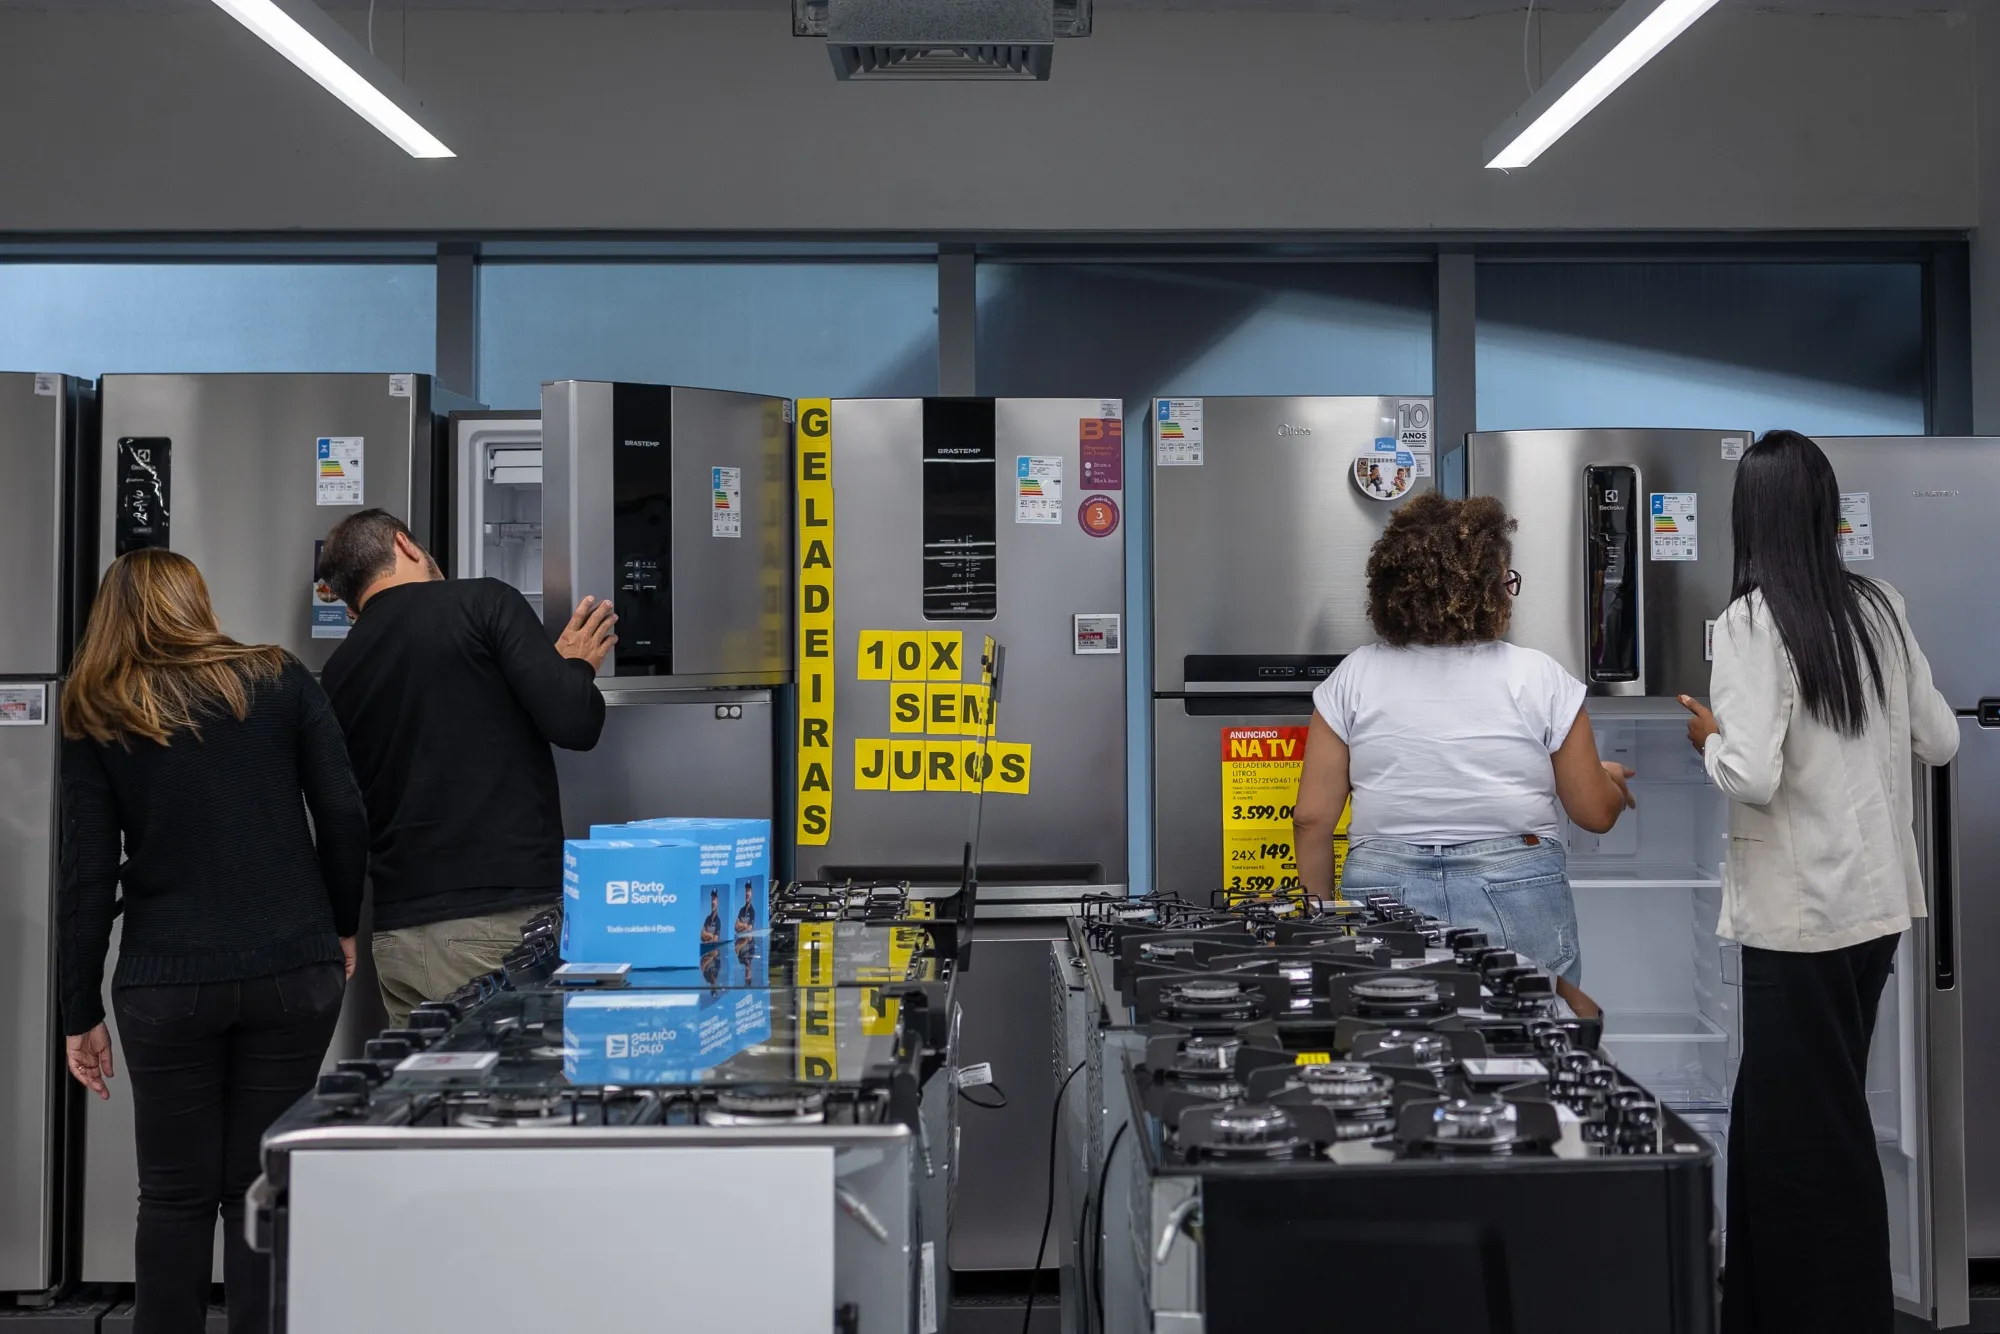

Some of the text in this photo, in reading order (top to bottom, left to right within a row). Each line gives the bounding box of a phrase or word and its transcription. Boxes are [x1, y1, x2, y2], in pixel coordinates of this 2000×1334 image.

[1399, 404, 1429, 428] 10
[1095, 507, 1104, 520] 3
[801, 408, 832, 836] GELADEIRAS
[867, 641, 959, 670] 10X
[895, 693, 994, 725] SEM
[1230, 731, 1278, 739] ANUNCIADO
[1231, 739, 1296, 758] NA TV
[861, 750, 1026, 783] JUROS
[1232, 850, 1256, 860] 24X
[631, 880, 664, 892] Porto
[631, 891, 677, 907] Serviço
